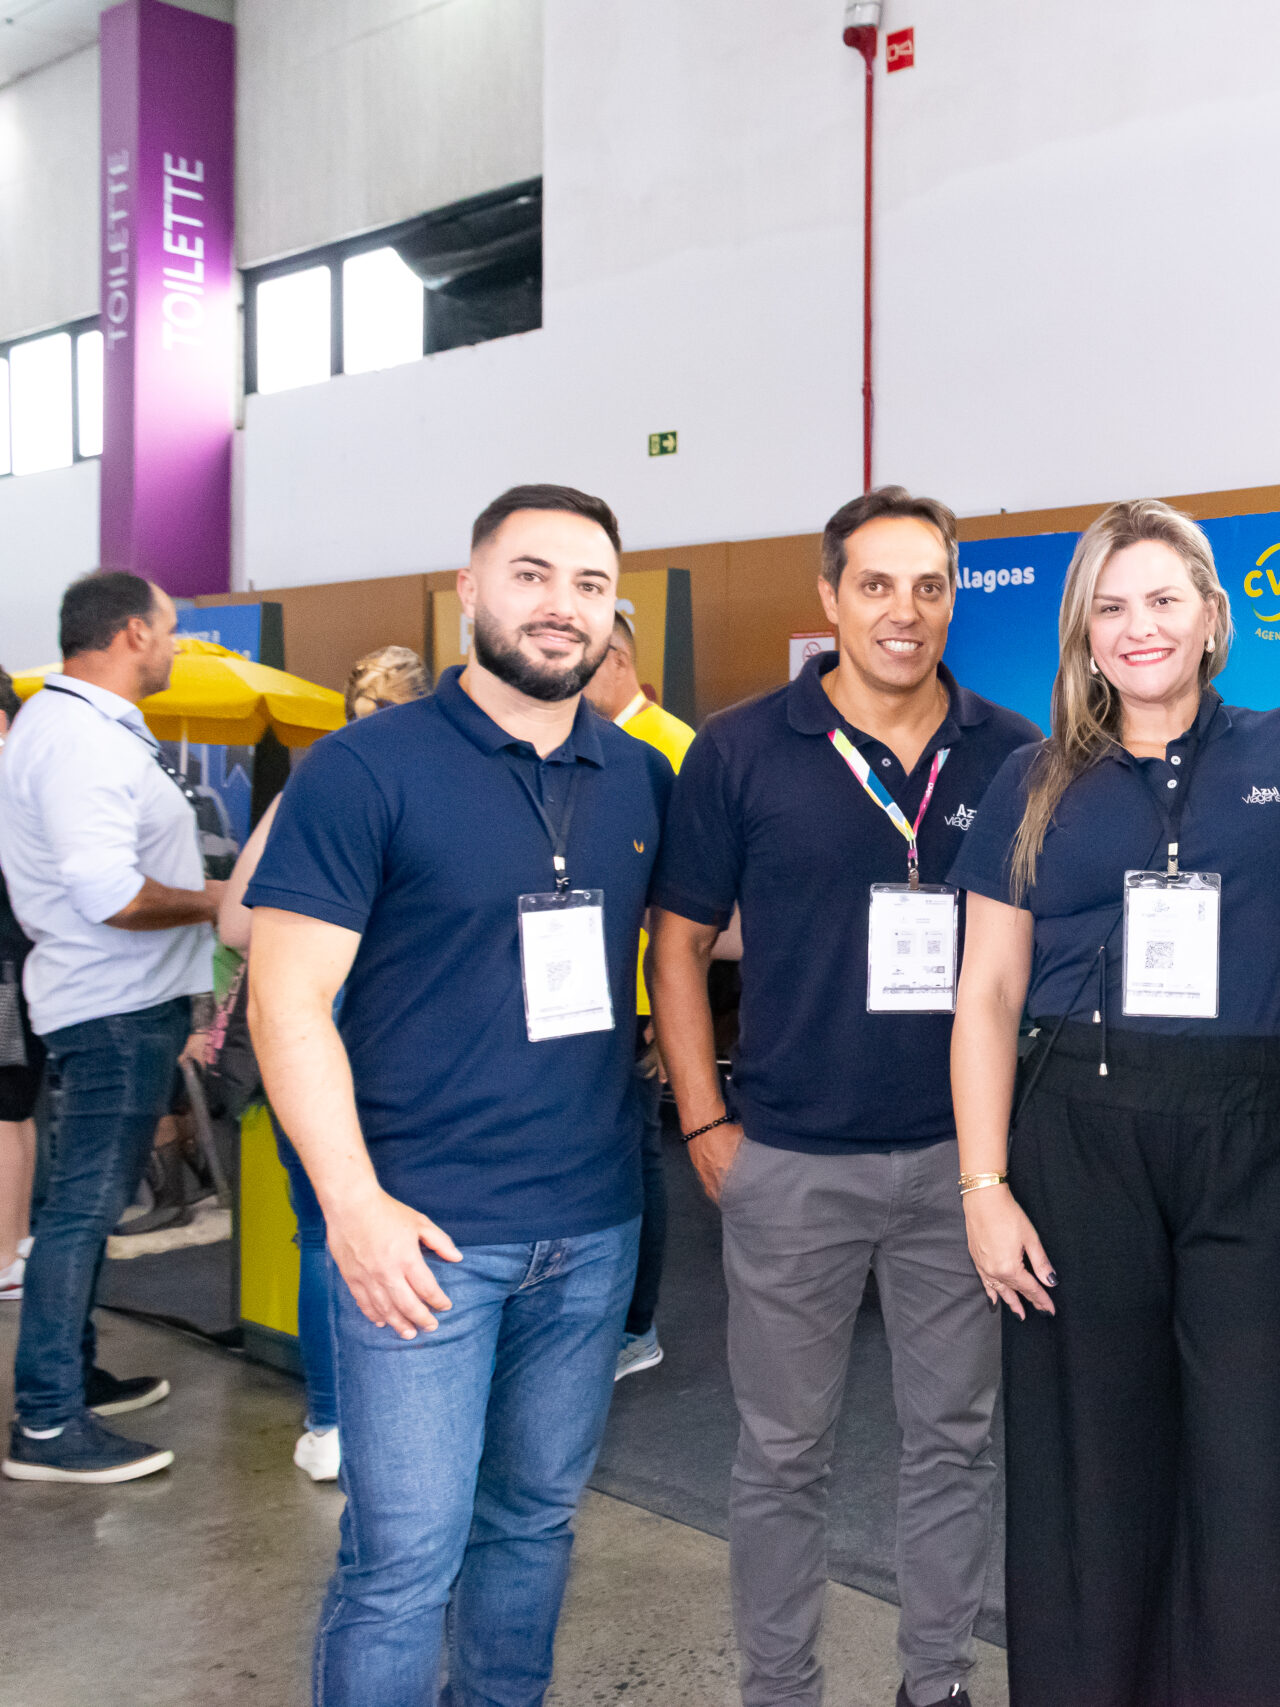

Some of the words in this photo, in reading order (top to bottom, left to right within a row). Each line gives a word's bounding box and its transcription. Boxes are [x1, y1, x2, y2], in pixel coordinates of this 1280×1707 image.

[106, 151, 129, 350] TOILETTE
[162, 152, 204, 350] TOILETTE
[956, 803, 977, 819] Az
[1252, 786, 1280, 797] Azul
